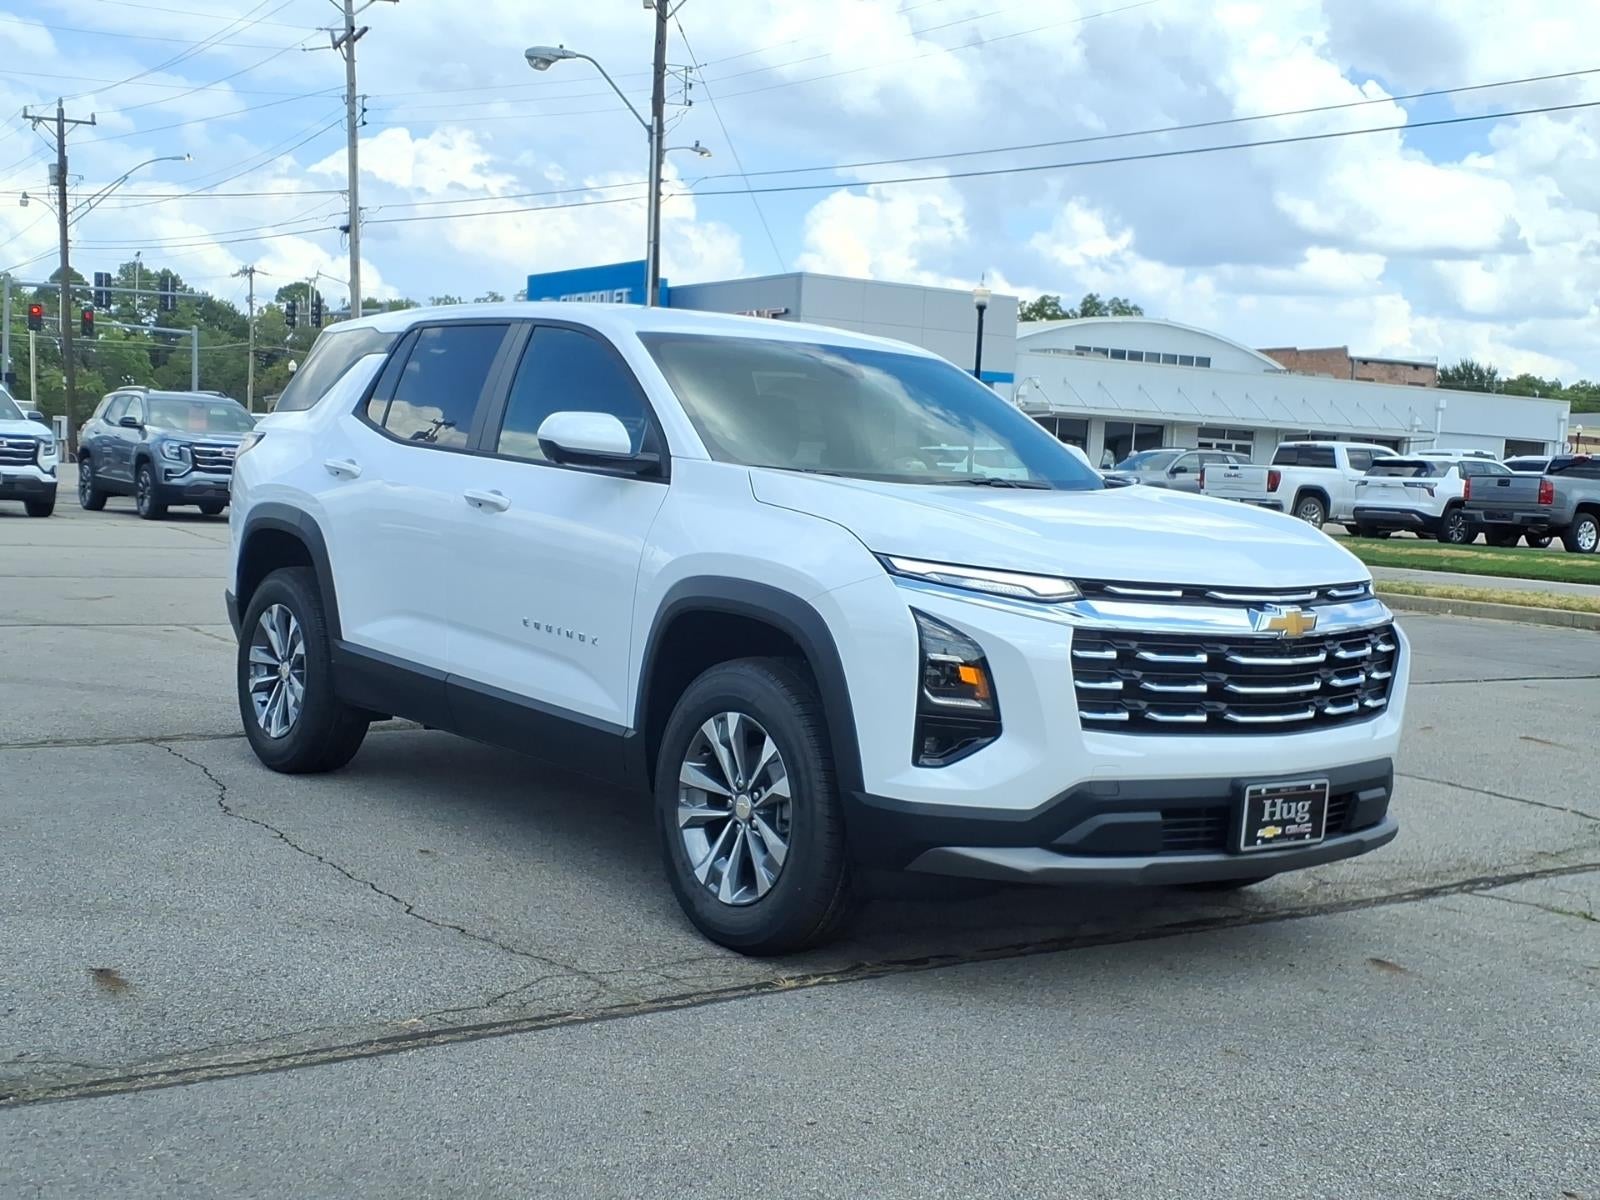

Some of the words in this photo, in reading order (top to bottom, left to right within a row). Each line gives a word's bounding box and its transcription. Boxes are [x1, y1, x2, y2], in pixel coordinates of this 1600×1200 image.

[522, 616, 599, 647] EQUINOX
[1261, 798, 1312, 823] Hug
[1285, 823, 1312, 835] GMC
